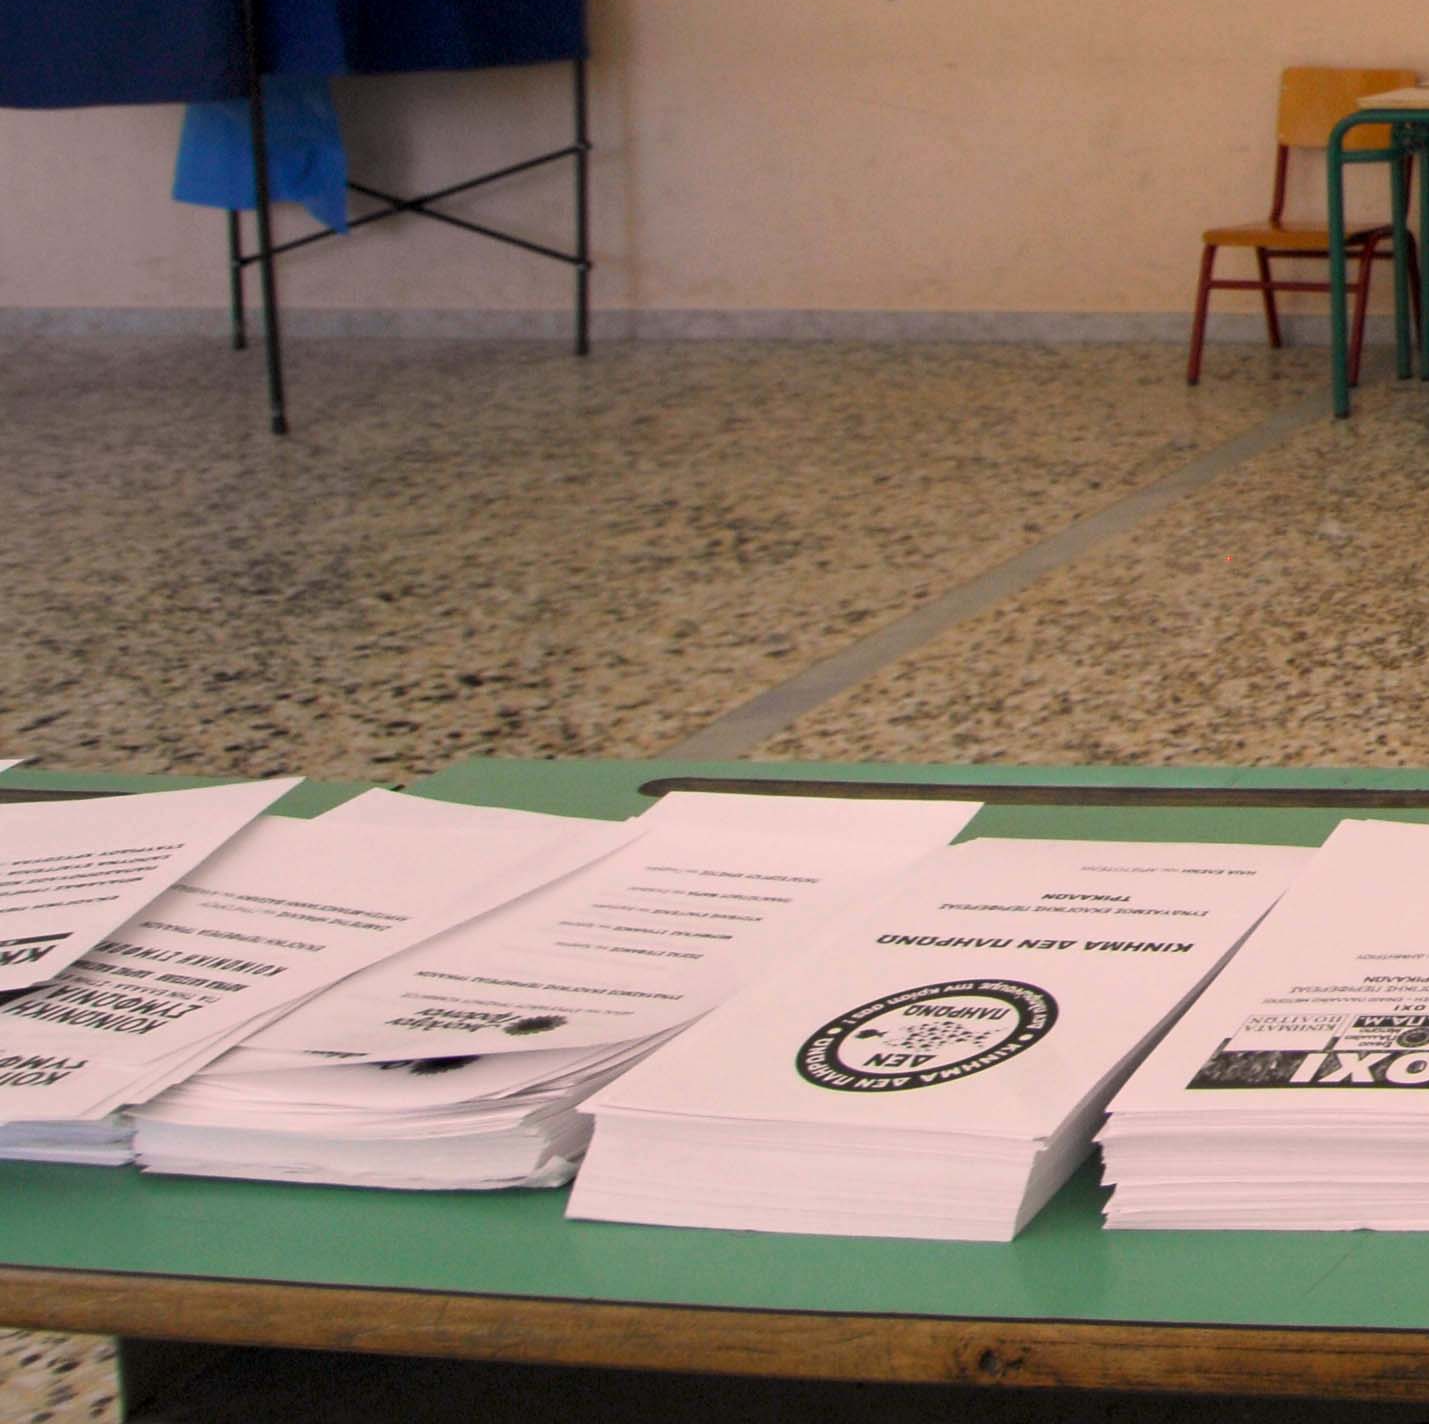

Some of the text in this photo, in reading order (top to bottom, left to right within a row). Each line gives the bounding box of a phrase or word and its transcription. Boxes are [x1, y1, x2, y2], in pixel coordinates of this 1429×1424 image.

[1040, 893, 1132, 903] ΤΡΙΚΑΛΩΝ
[875, 934, 1195, 954] ΚΙΝΗΜΑ ΔΕΝ ΠΛΗΡΩΝΩ
[0, 944, 57, 967] ΚΚ
[46, 986, 203, 1019] ΣΥΜΦΩΝΙΑ
[1394, 1004, 1428, 1012] ΟΧΙ
[2, 1001, 167, 1035] ΚΟΙΝΩΝΙΚΗ
[901, 1004, 1012, 1020] ΠΛΗΡΩΝΩ
[862, 1053, 938, 1068] ΔΕΝ
[917, 1043, 1023, 1083] ΚΙΝΗΜΑ
[853, 1075, 912, 1088] ΔΕΝ
